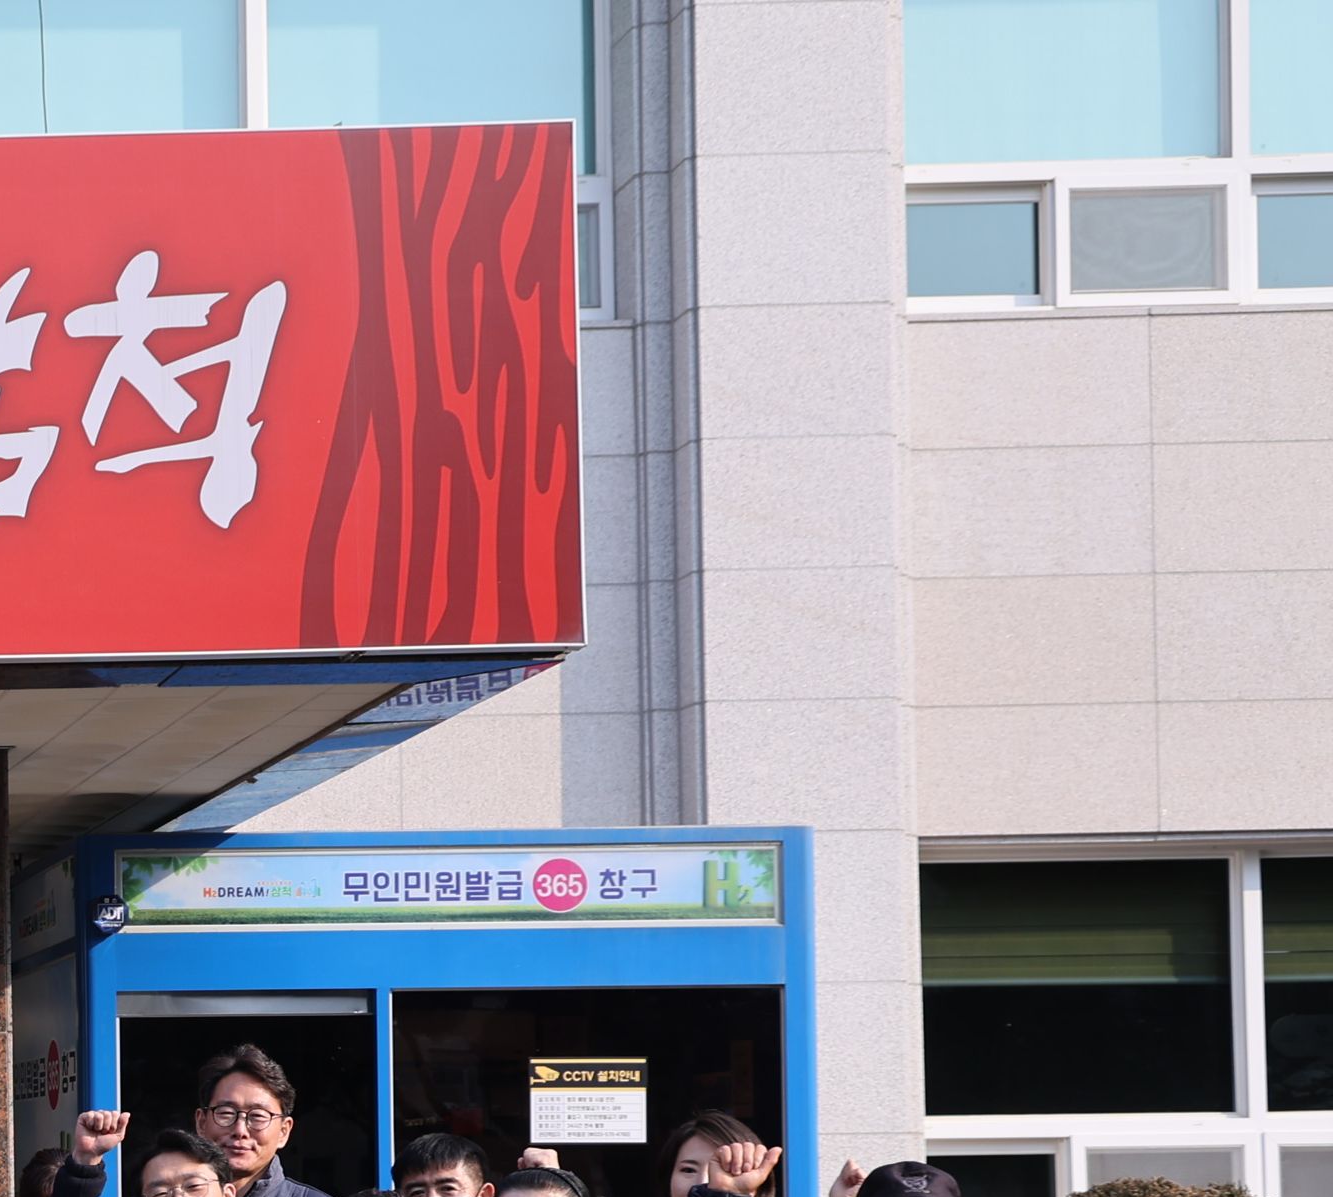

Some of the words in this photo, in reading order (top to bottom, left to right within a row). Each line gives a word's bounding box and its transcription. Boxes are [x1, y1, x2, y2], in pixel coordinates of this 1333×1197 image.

[343, 870, 523, 903] 무인민원발급
[536, 873, 583, 897] 365
[599, 868, 658, 900] 창구
[98, 906, 124, 920] ADT
[562, 1071, 595, 1082] CCTV
[597, 1070, 641, 1083] 설치안내
